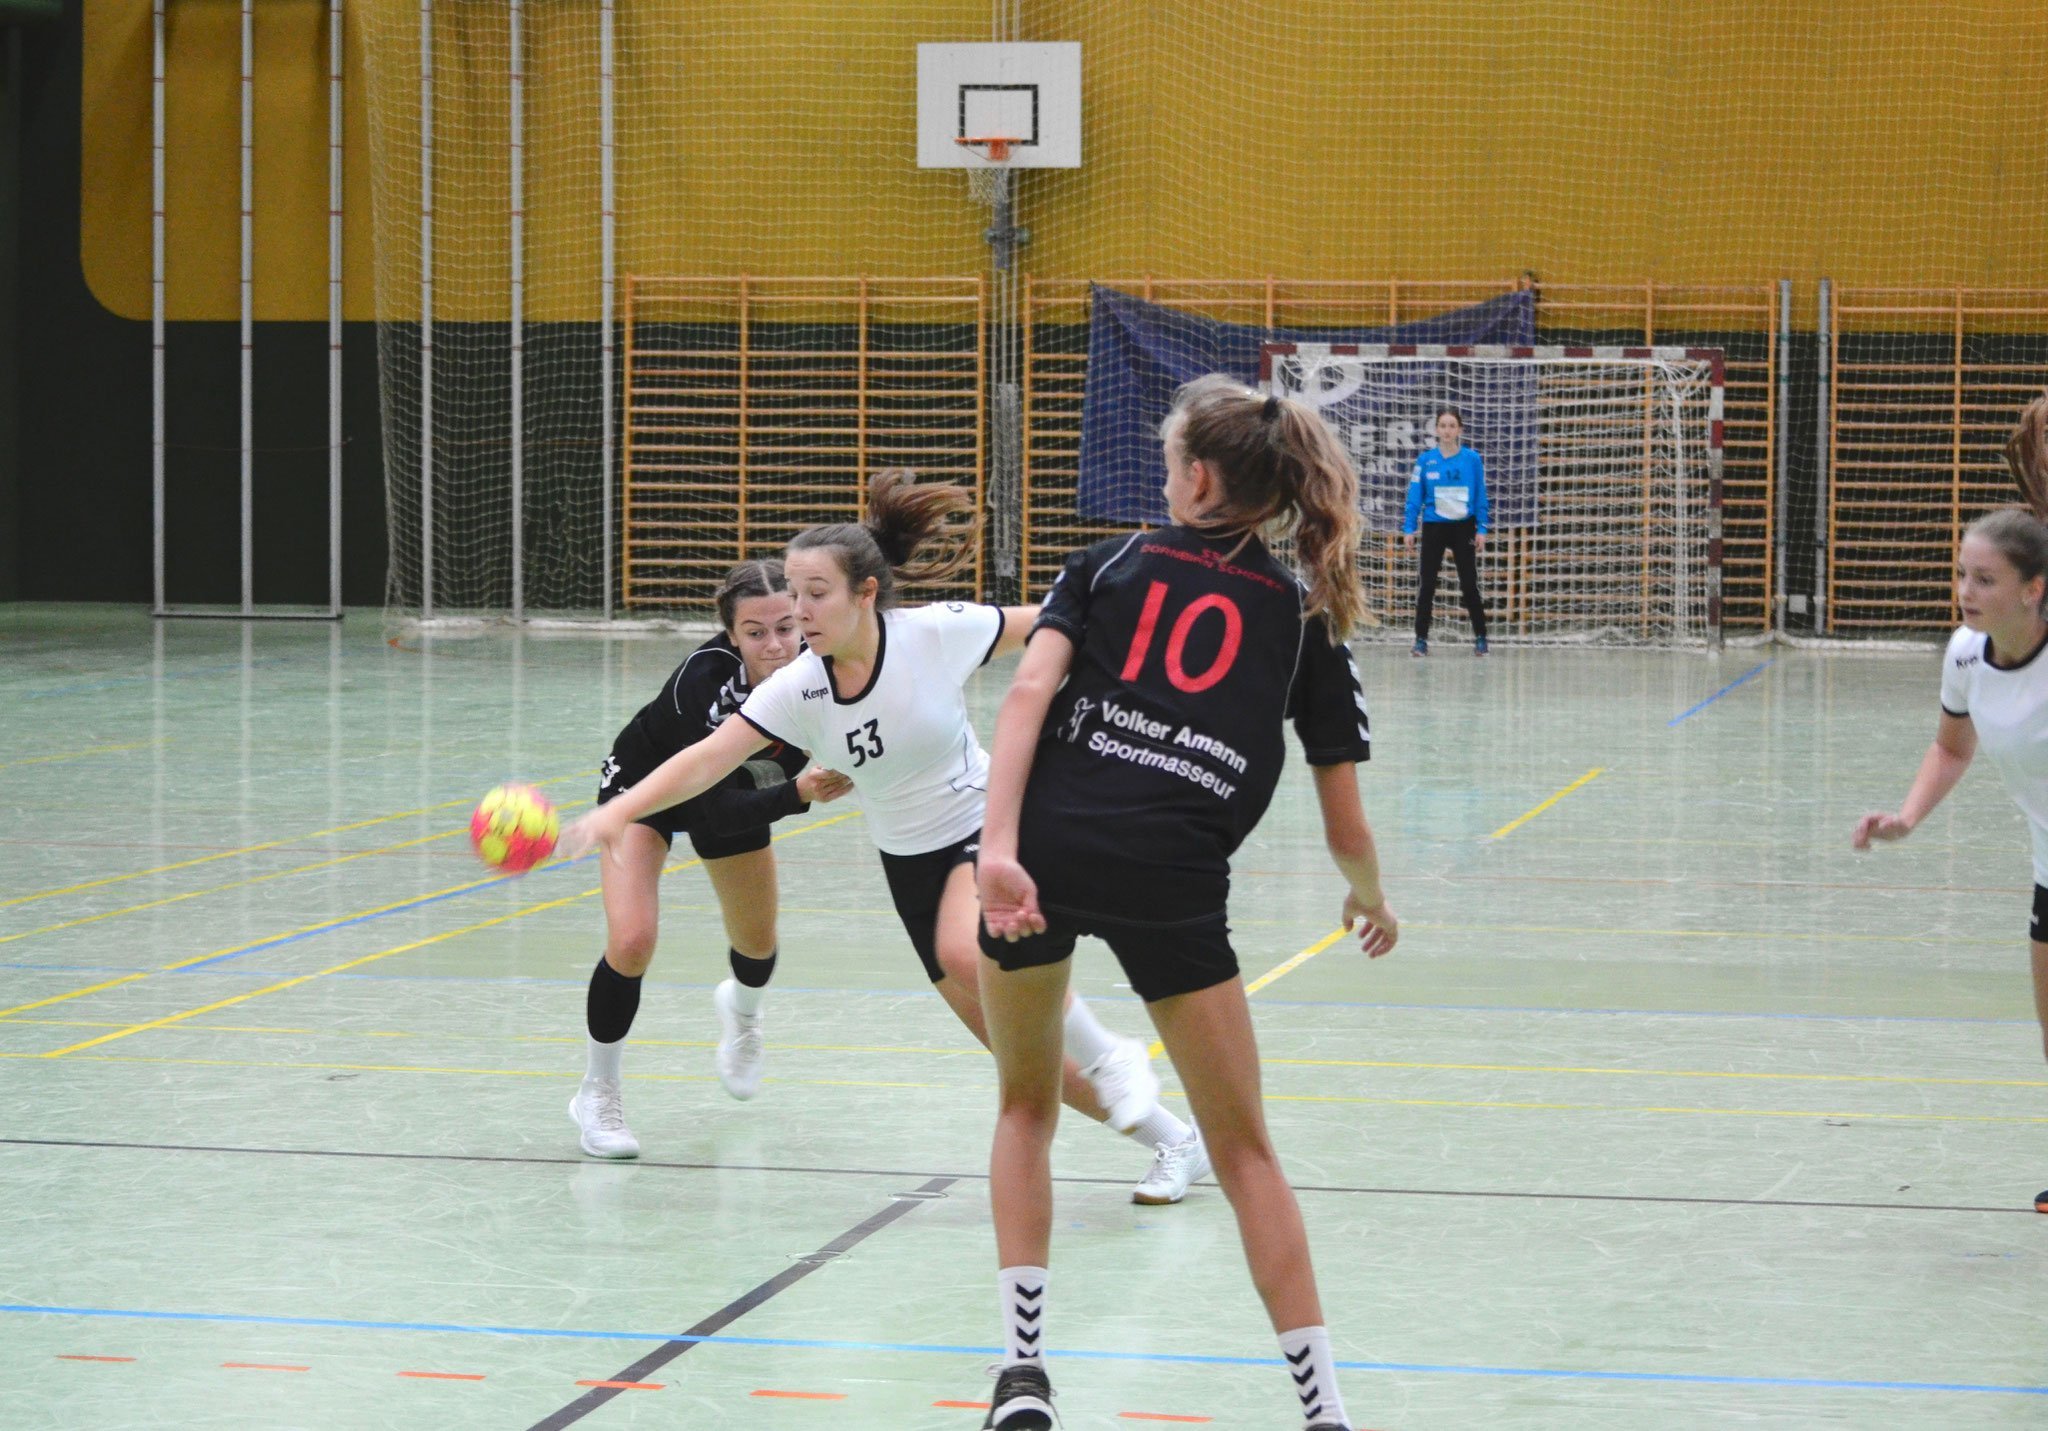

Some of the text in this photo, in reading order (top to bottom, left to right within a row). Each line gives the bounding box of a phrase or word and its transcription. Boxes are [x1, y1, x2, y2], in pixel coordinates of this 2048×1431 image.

[1446, 469, 1461, 480] 12
[1121, 580, 1242, 693] 10
[846, 719, 884, 768] 53
[1088, 731, 1236, 800] Sportmasseur
[1101, 701, 1248, 774] Volker Amann
